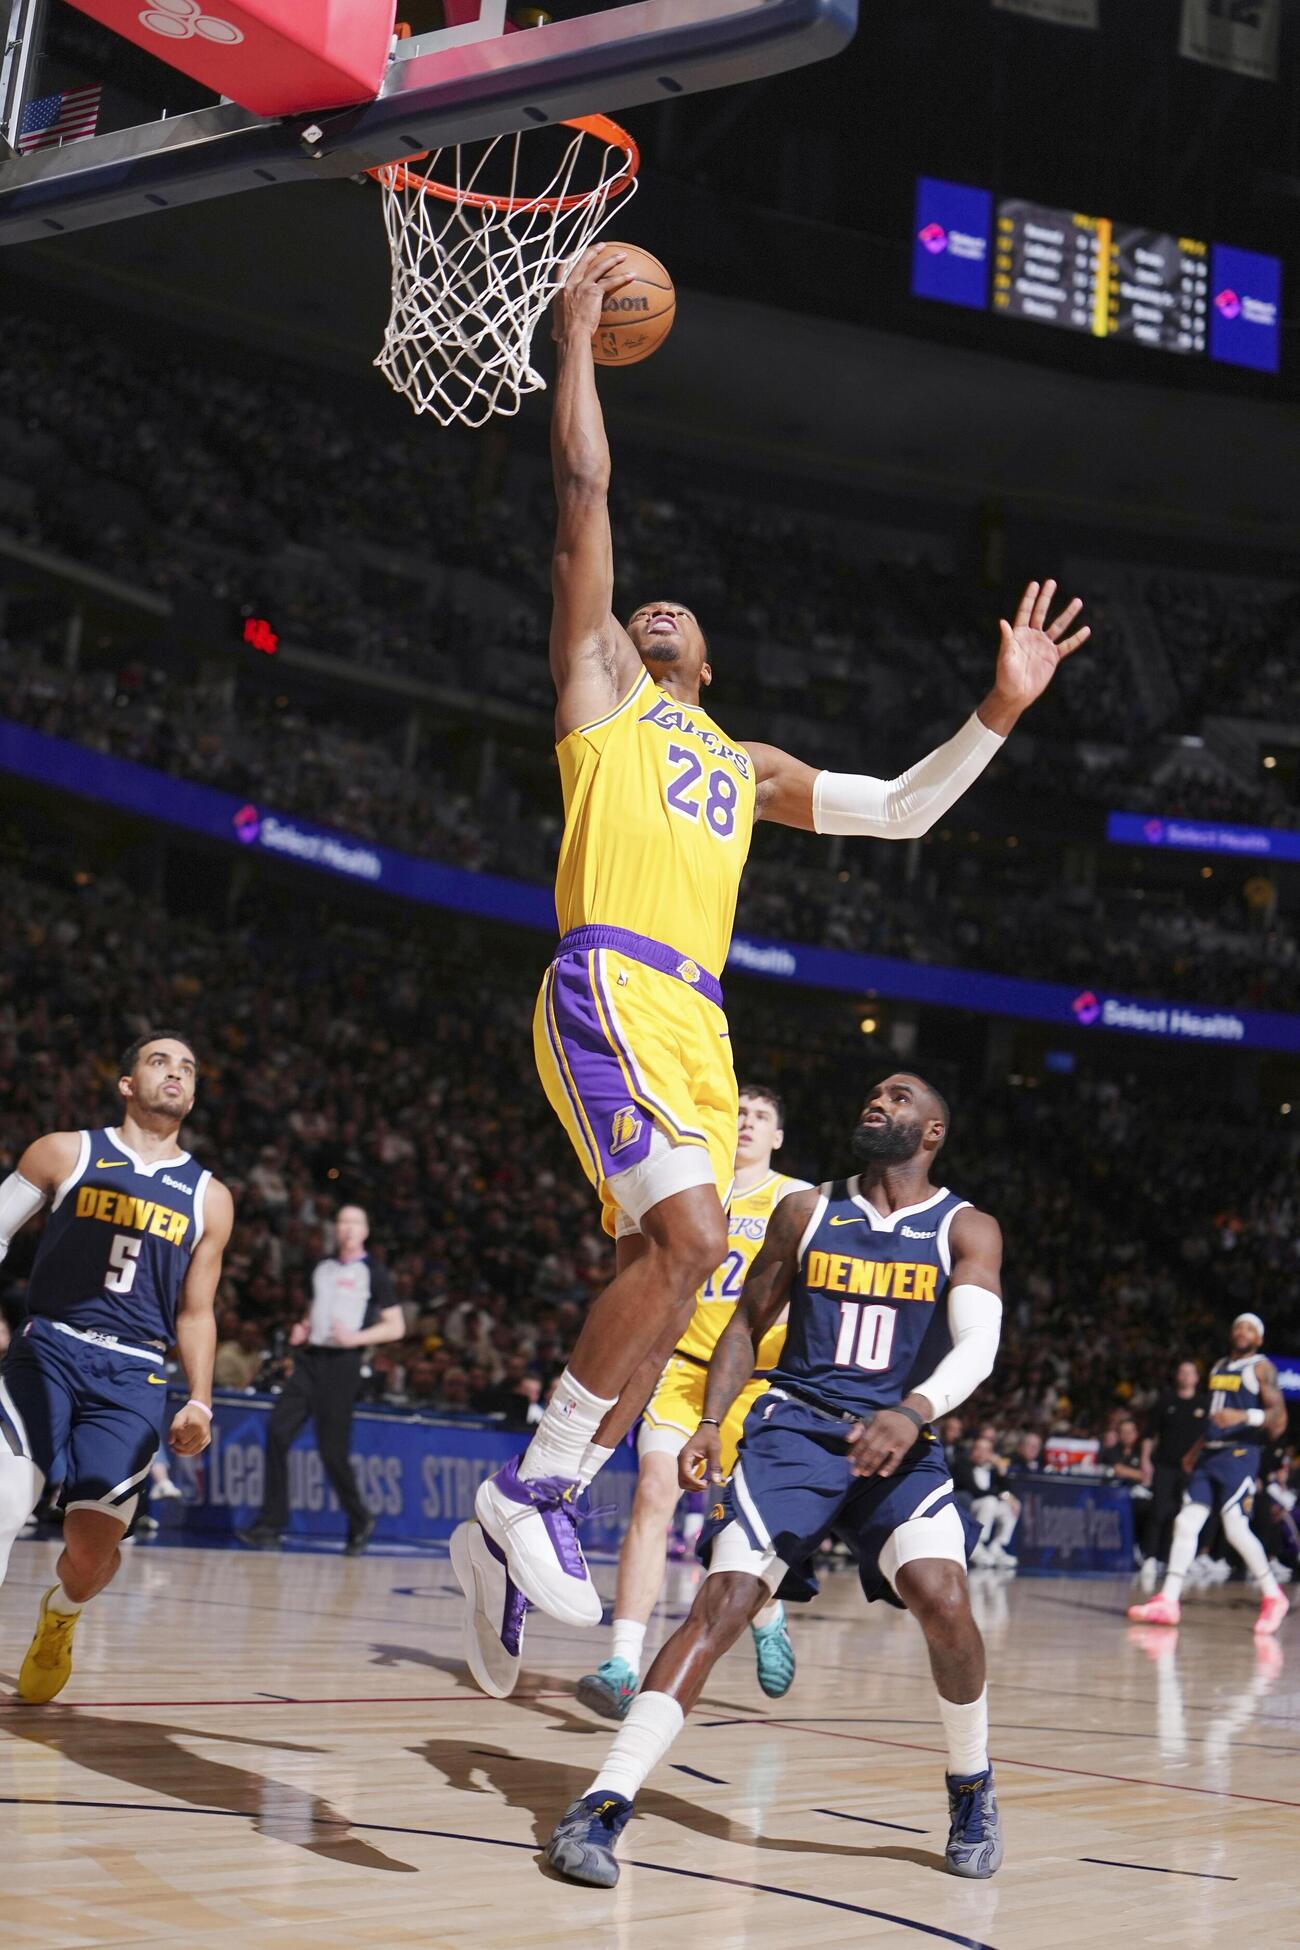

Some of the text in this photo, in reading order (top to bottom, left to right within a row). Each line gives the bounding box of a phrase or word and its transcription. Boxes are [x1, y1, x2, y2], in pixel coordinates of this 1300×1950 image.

[667, 744, 738, 838] 28
[1103, 999, 1244, 1040] Select Health
[76, 1186, 190, 1247] DENVER
[104, 1234, 142, 1293] 5
[807, 1250, 938, 1302] DENVER
[834, 1301, 897, 1370] 10
[209, 1425, 324, 1512] Leaue
